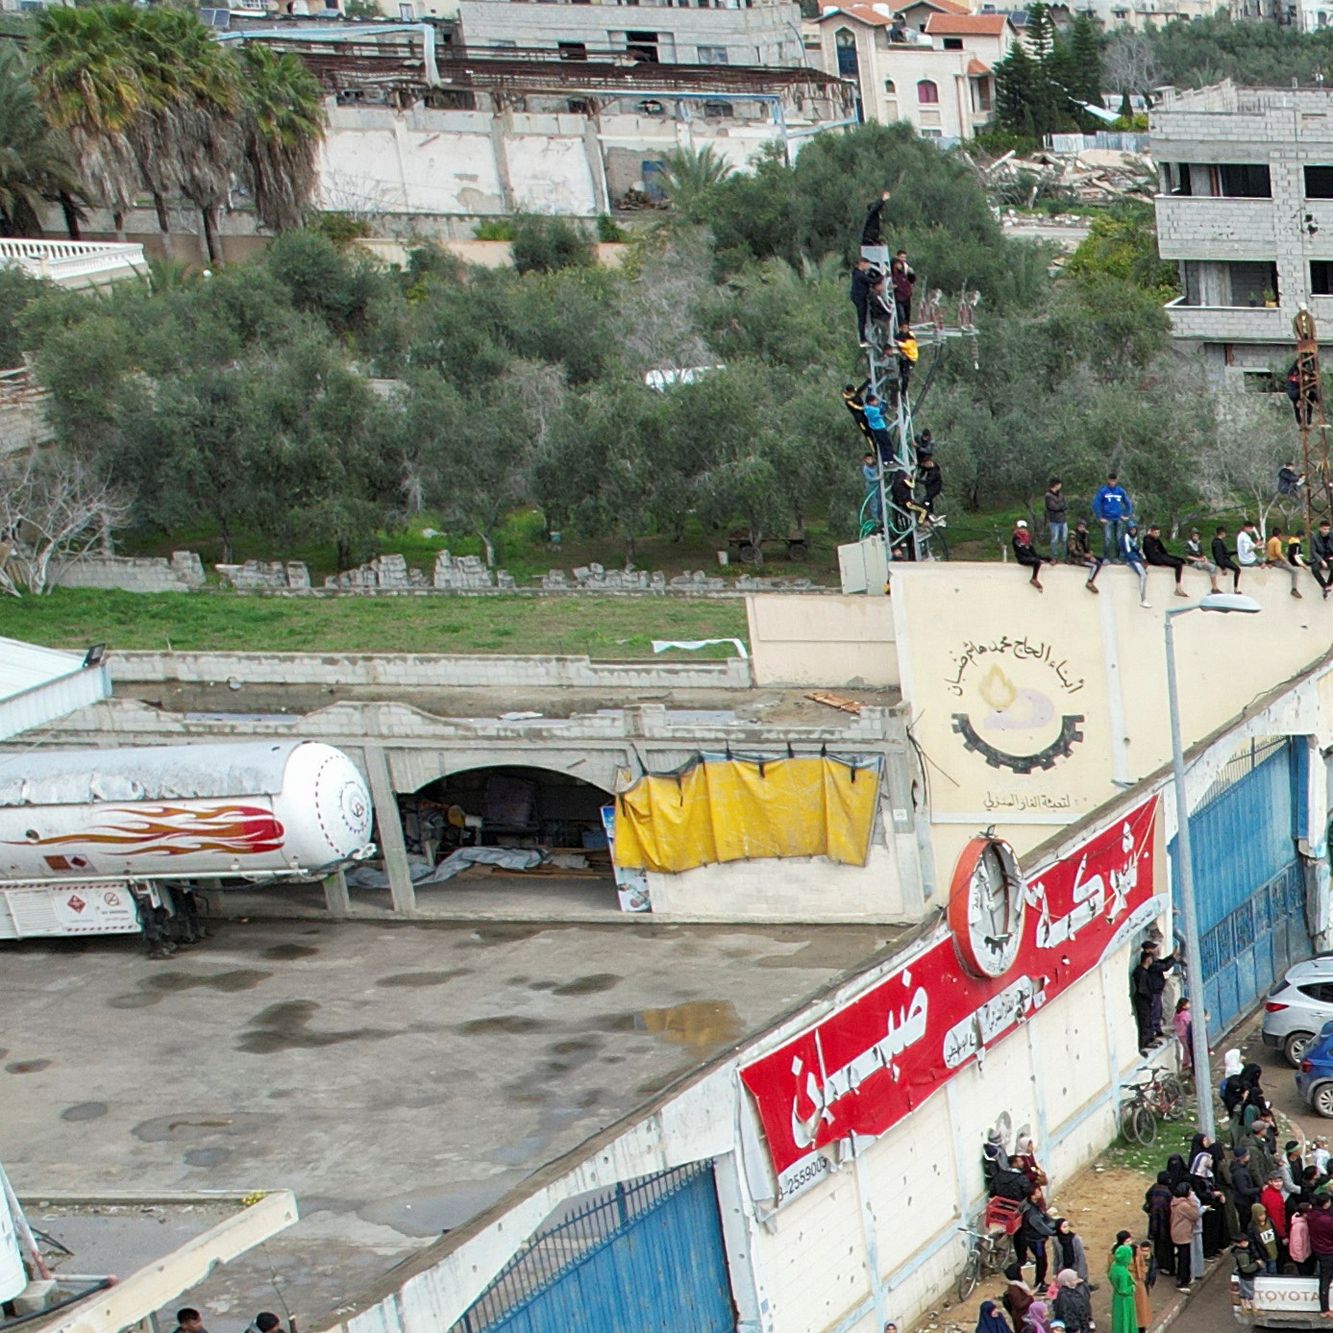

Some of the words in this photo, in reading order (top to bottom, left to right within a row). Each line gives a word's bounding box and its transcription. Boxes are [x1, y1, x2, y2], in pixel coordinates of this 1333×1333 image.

[988, 636, 1012, 653] محمد
[1013, 636, 1051, 662] الحاج
[1024, 821, 1138, 948] شركة
[1255, 1290, 1320, 1301] TOYOTA
